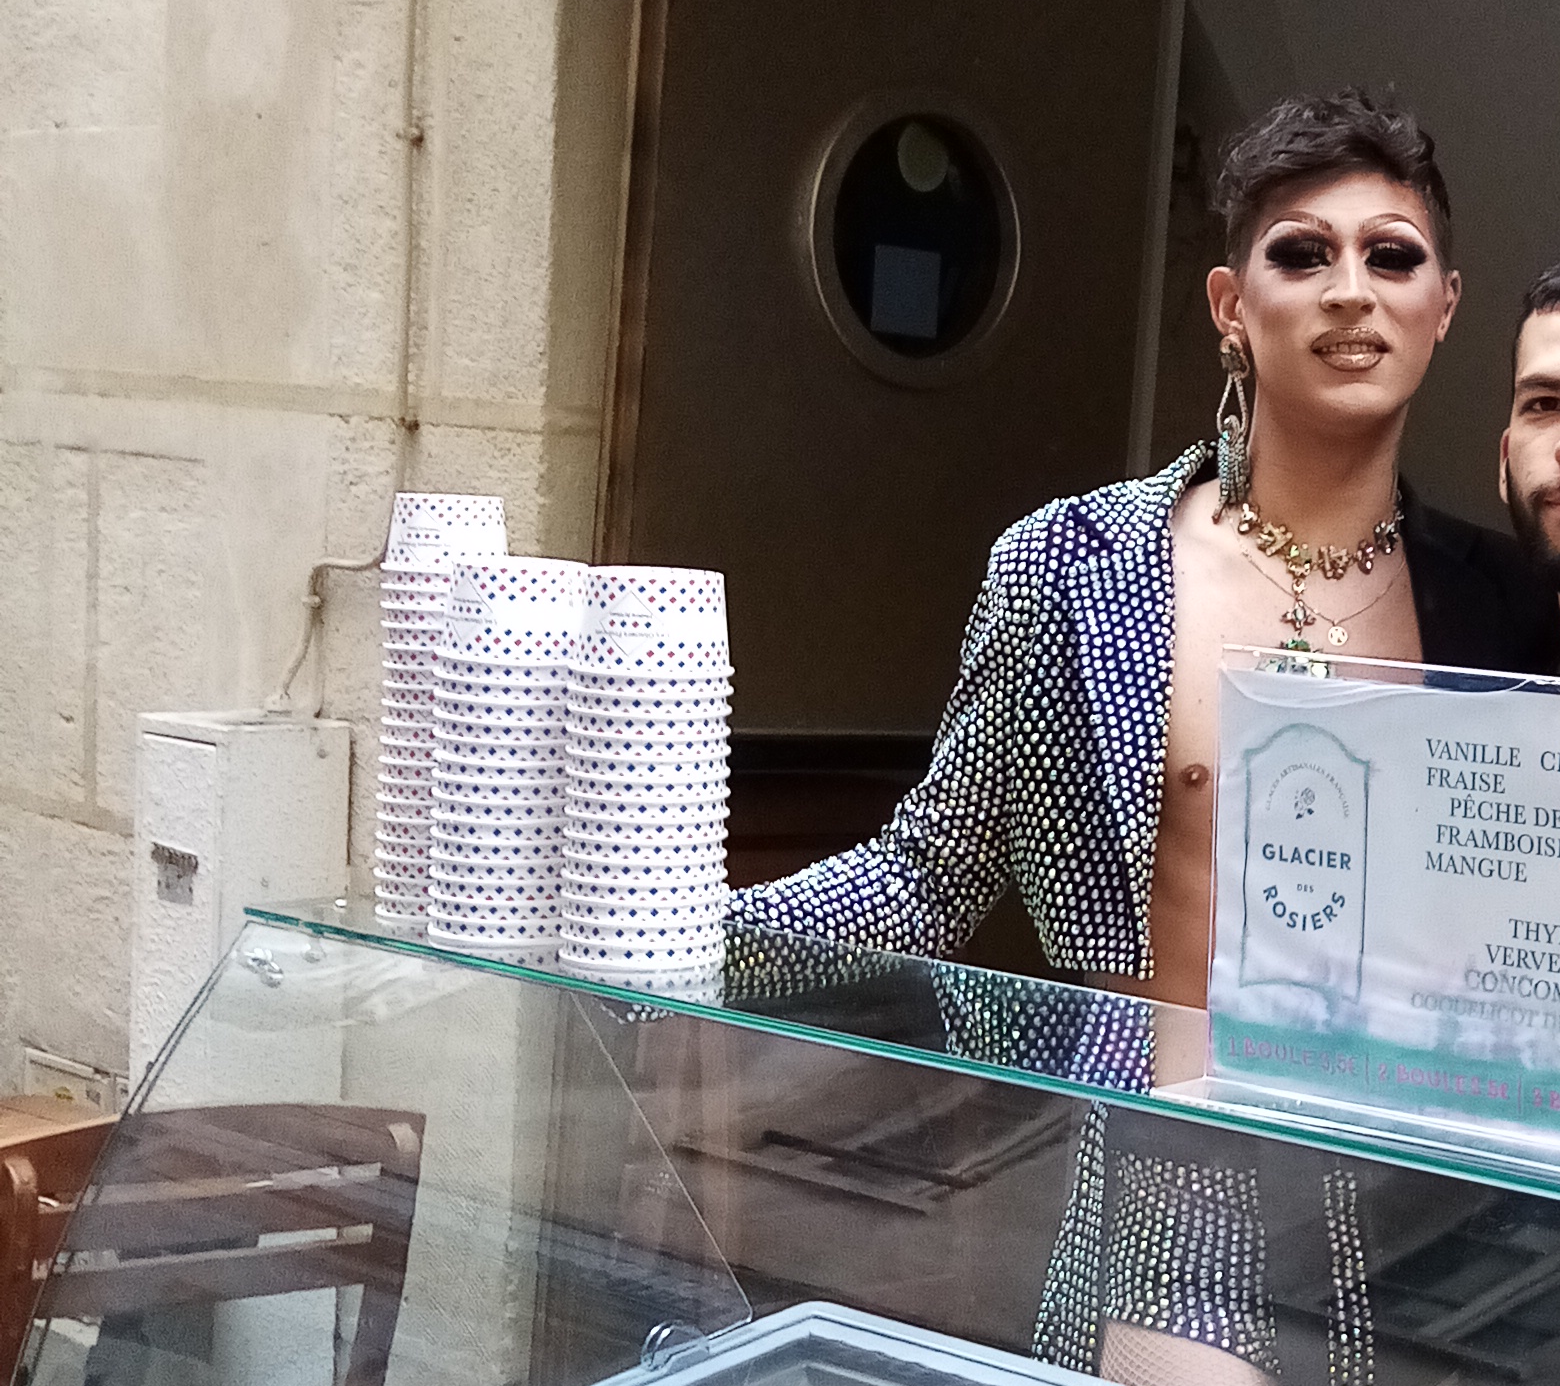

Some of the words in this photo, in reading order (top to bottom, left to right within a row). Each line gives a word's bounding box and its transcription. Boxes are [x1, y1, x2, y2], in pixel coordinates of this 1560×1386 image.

[1425, 738, 1521, 768] VANILLE
[1426, 766, 1506, 795] FRAISE
[1449, 793, 1526, 826] PÊCHE
[1262, 842, 1351, 871] GLACIER
[1424, 850, 1528, 883] MANGUE
[1297, 883, 1314, 894] DES
[1263, 885, 1346, 932] ROSIERS
[1243, 1036, 1313, 1067] BOULE
[1395, 1063, 1482, 1097] BOULES
